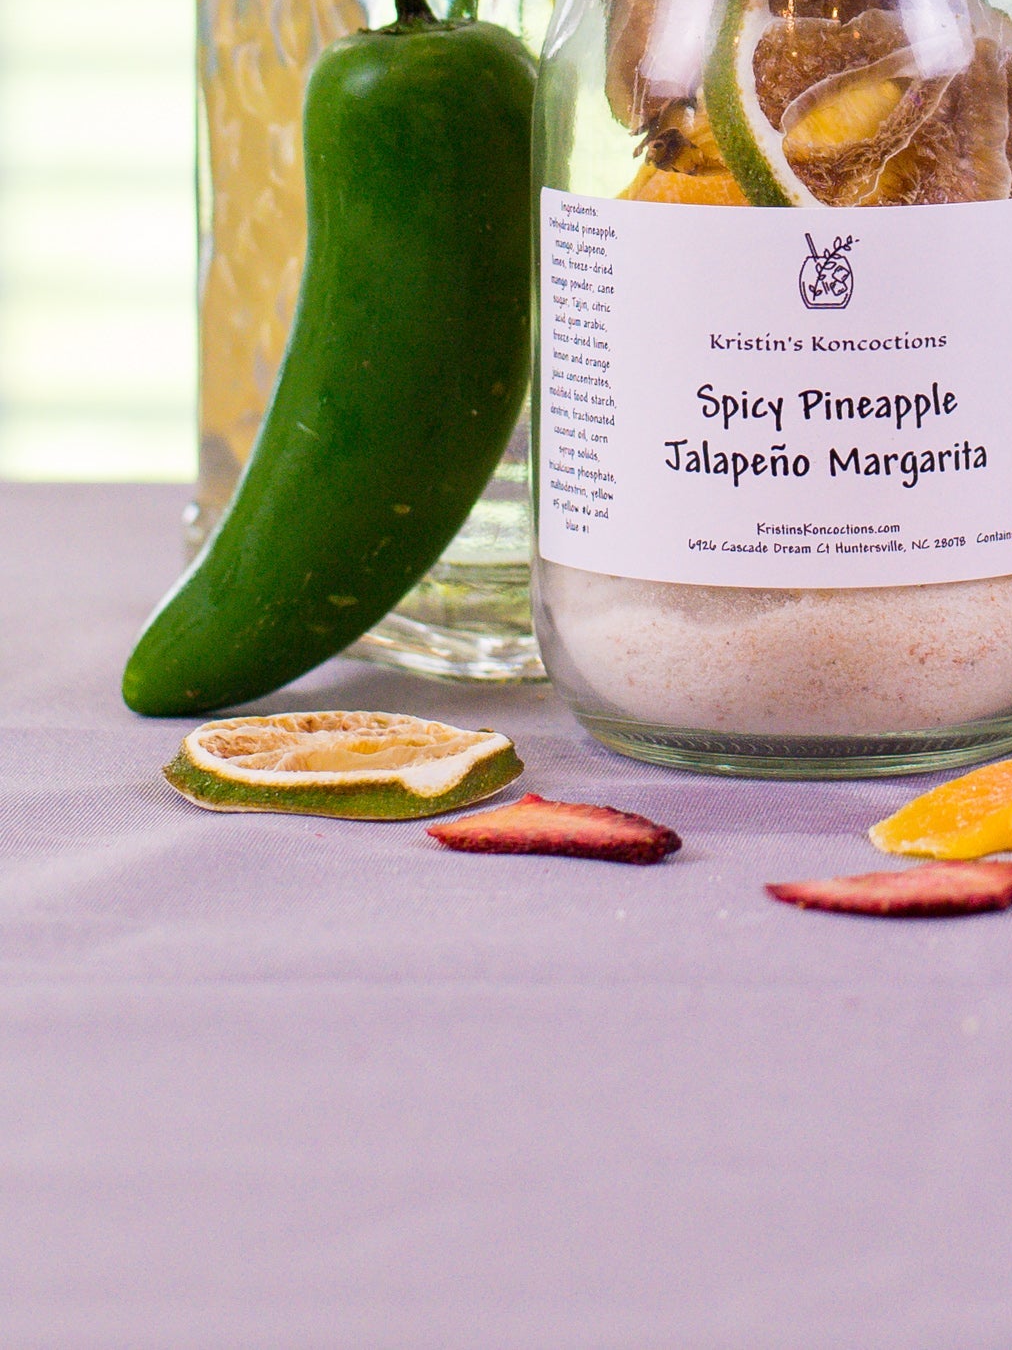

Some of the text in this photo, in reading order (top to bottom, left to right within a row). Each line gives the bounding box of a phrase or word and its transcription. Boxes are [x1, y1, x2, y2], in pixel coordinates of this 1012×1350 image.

[582, 226, 618, 241] pineapple,
[569, 257, 613, 275] freeze-dried
[570, 278, 595, 293] powder,
[597, 284, 615, 294] cane
[592, 302, 611, 313] citric
[568, 317, 581, 329] gum
[584, 318, 608, 332] arabic,
[553, 329, 611, 352] freeze-dried lime,
[710, 331, 947, 352] Kristin's Koncoctions
[571, 353, 583, 364] and
[585, 357, 610, 373] orange
[566, 373, 611, 389] concentrates,
[573, 390, 588, 403] food
[591, 395, 617, 409] starch,
[696, 382, 958, 432] Spicy Pineapple
[572, 407, 615, 426] fractionated
[591, 433, 609, 444] corn
[559, 445, 600, 462] syrup solids,
[664, 439, 988, 488] Jalapeño Margarita
[577, 466, 617, 484] phosphate,
[591, 488, 614, 502] yellow
[561, 500, 579, 514] yellow
[594, 508, 609, 519] and
[566, 518, 579, 532] blue
[757, 522, 900, 537] KristinsKoncoctions.com
[688, 536, 967, 554] 6926 Cascade Dream Ct Huntersville, NC 28078
